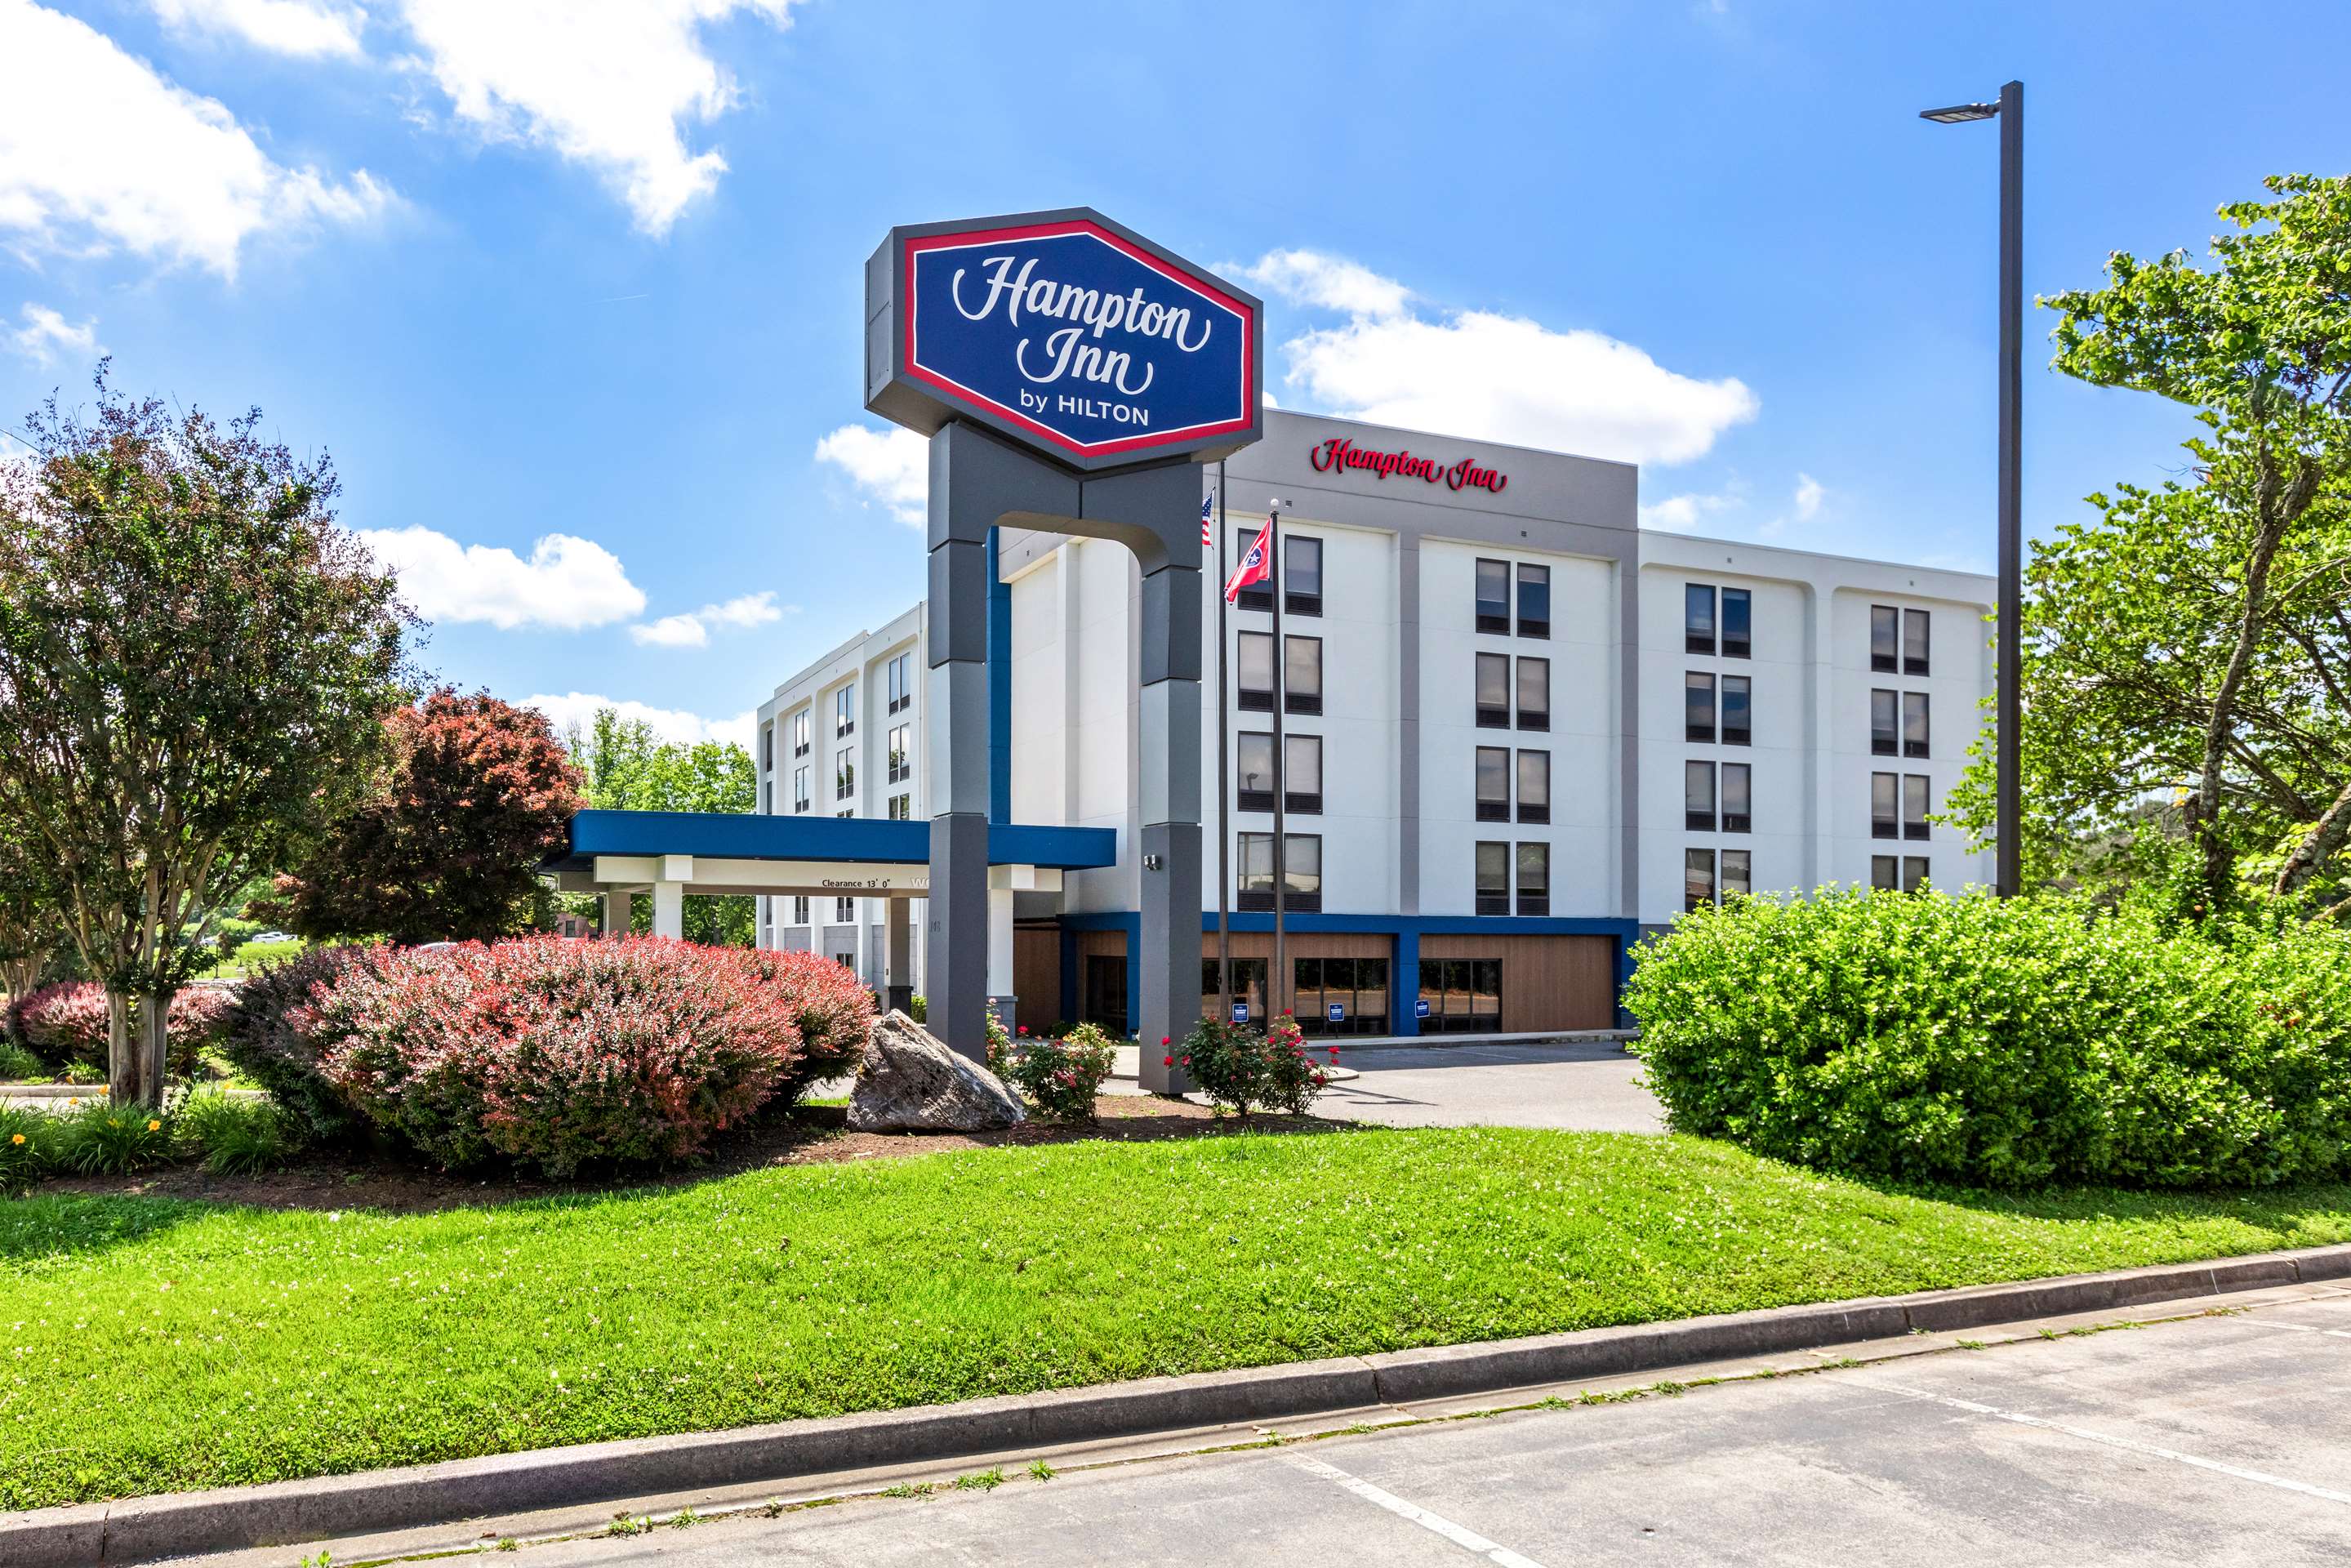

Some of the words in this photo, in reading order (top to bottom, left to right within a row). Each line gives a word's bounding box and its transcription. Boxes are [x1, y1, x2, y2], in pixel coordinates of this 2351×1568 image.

[952, 256, 1211, 352] Hampton
[1015, 328, 1153, 395] Inn
[1021, 388, 1049, 413] by
[1058, 394, 1149, 426] HILTON
[1311, 439, 1445, 483] Hampton
[1447, 458, 1507, 492] Inn
[822, 880, 862, 888] Clearance
